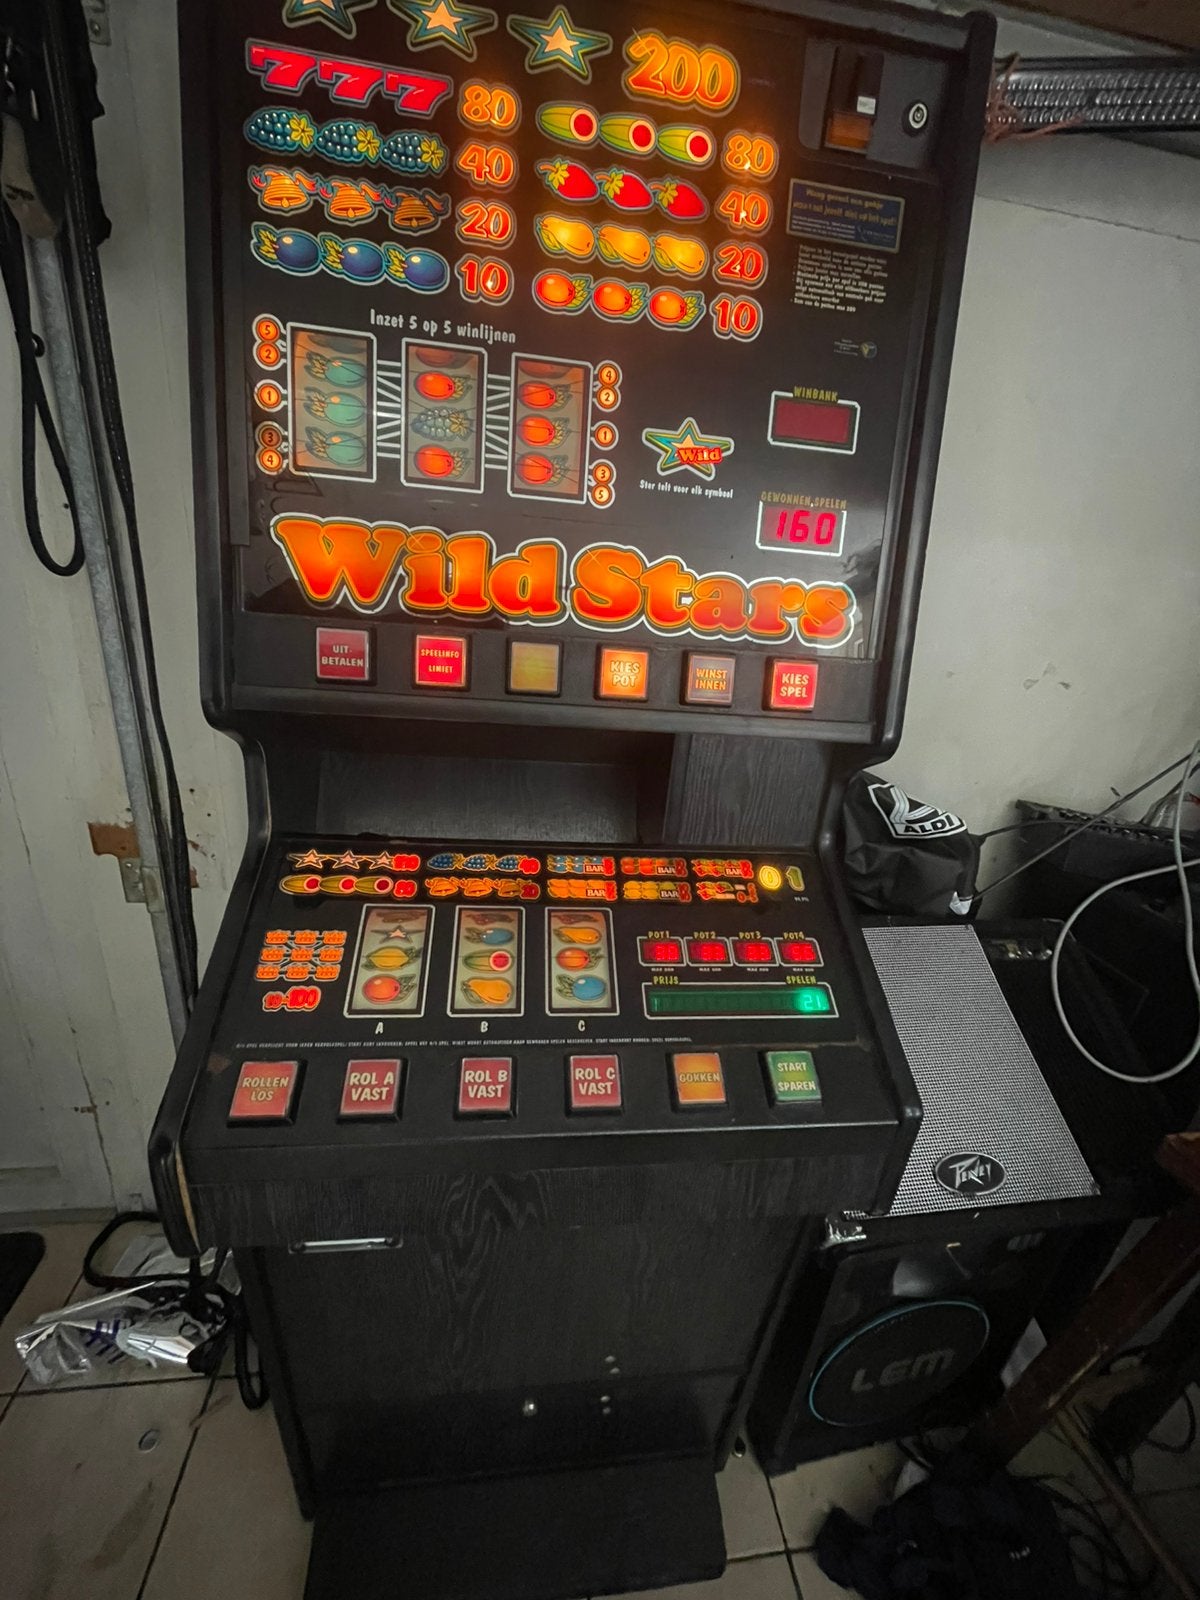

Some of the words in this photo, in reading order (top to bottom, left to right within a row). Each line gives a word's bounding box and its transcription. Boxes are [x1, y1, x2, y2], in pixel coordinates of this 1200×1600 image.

[627, 34, 736, 107] 200
[463, 84, 518, 128] 80
[728, 134, 775, 174] 80
[459, 143, 514, 185] 40
[719, 190, 769, 228] 40
[460, 200, 511, 241] 20
[718, 245, 764, 281] 20
[460, 259, 509, 297] 10
[714, 297, 759, 335] 10
[370, 308, 404, 329] Inzet
[409, 315, 418, 330] 5
[423, 320, 438, 337] op
[443, 320, 452, 335] 5
[456, 322, 517, 345] winlijnen
[793, 386, 839, 402] WINBANK
[677, 448, 722, 464] Wild
[691, 484, 703, 495] elk
[704, 488, 734, 499] symbool
[760, 491, 811, 507] GEWONNEN
[813, 494, 847, 510] SPELEN
[775, 509, 837, 545] 160
[274, 516, 564, 620] Wild
[571, 546, 851, 642] Stars
[420, 648, 460, 659] SPEELINFO
[321, 656, 364, 668] BETALEN
[427, 664, 453, 674] LIMIET
[610, 659, 640, 674] KIES
[612, 674, 637, 688] POT
[696, 668, 728, 680] WINST
[781, 672, 809, 686] KIES
[695, 679, 726, 691] INNEN
[780, 685, 808, 699] SPEL
[903, 814, 954, 834] ALDI
[653, 975, 679, 985] PRIJS
[785, 975, 817, 985] SPELEN
[375, 1021, 384, 1034] A
[480, 1021, 489, 1033] B
[577, 1020, 586, 1032] C
[575, 1067, 602, 1080] ROL
[605, 1066, 616, 1080] C
[777, 1062, 807, 1073] START
[242, 1076, 289, 1088] ROLLEN
[349, 1072, 378, 1086] ROL
[383, 1071, 395, 1085] A
[464, 1070, 493, 1083] ROL
[497, 1069, 508, 1083] B
[679, 1072, 722, 1083] GOKKEN
[467, 1085, 504, 1099] VAST
[578, 1082, 613, 1096] VAST
[777, 1080, 817, 1092] SPAREN
[250, 1090, 273, 1101] LOS
[351, 1087, 390, 1101] VAST
[949, 1155, 992, 1189] PEAVEY
[851, 1349, 955, 1393] LEM
